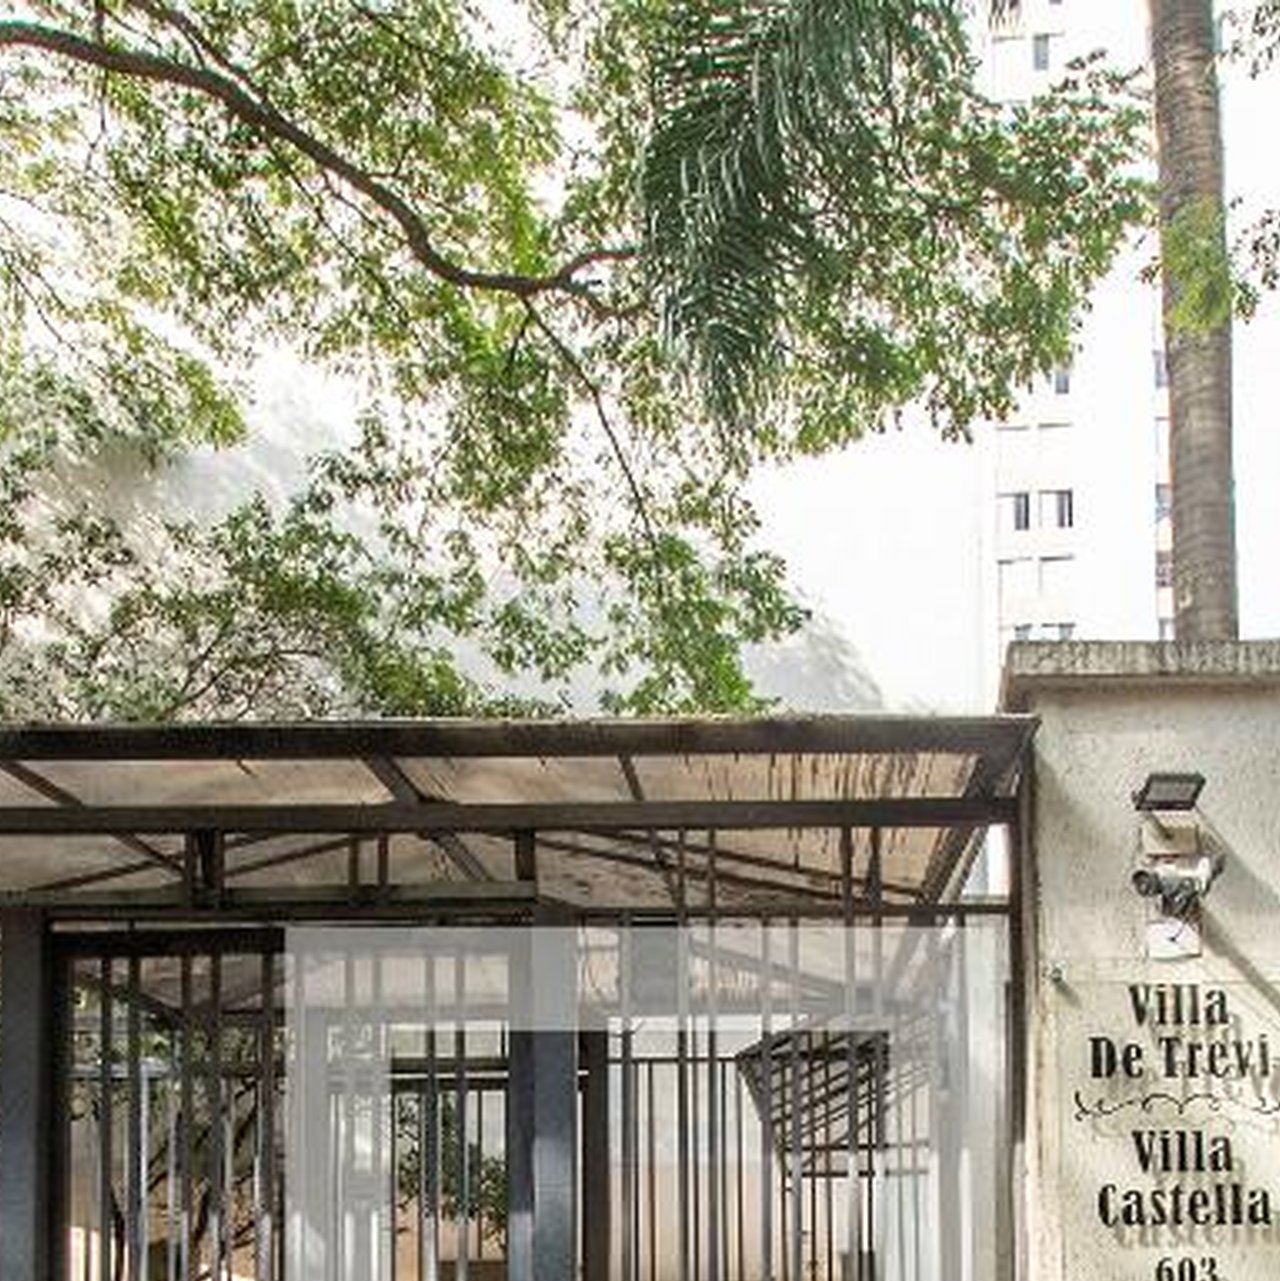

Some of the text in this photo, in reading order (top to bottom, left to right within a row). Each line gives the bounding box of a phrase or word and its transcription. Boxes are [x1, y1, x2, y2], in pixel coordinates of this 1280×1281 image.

[1128, 983, 1230, 1025] Villa
[1089, 1034, 1270, 1079] De Trevi
[1131, 1129, 1233, 1172] Villa
[1098, 1184, 1272, 1227] Castella
